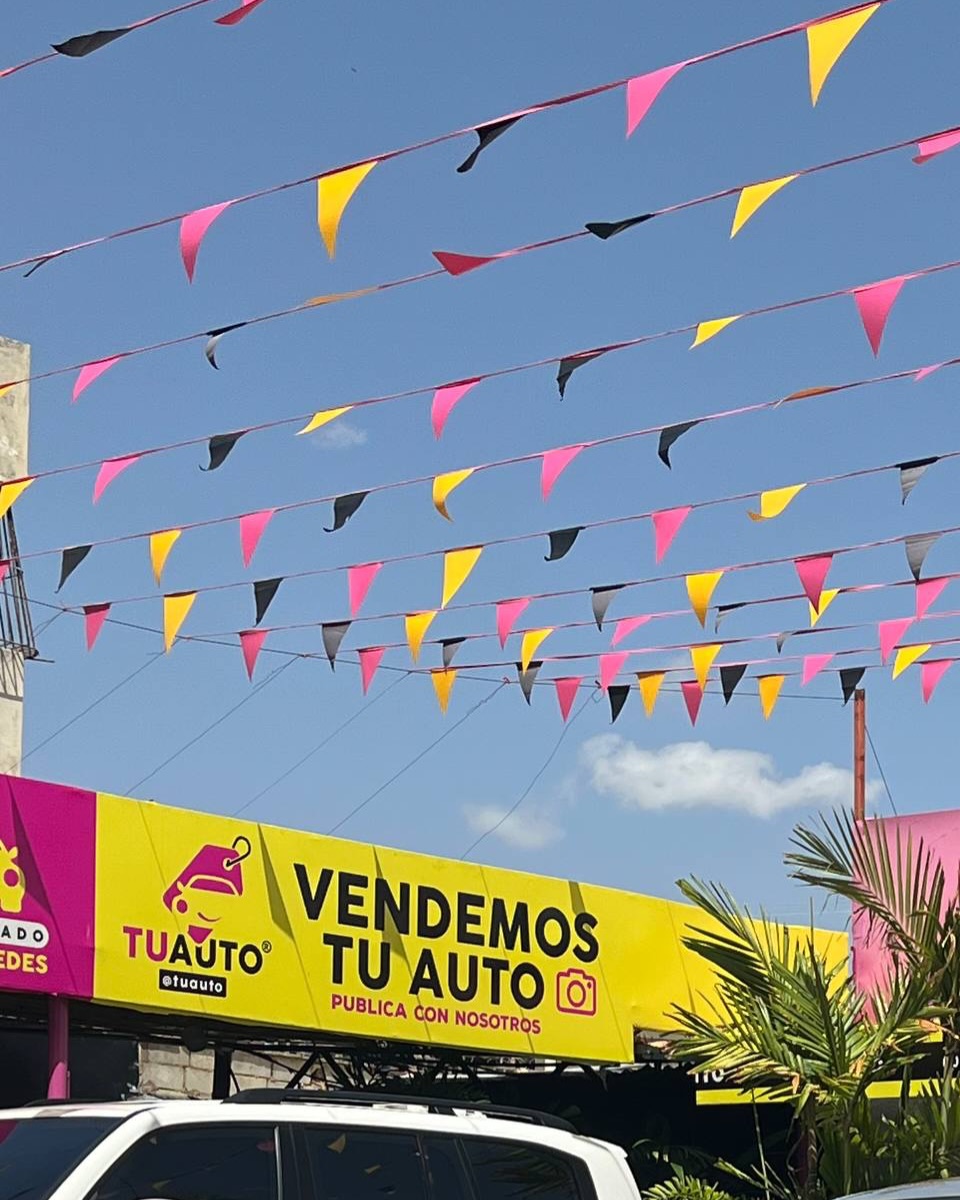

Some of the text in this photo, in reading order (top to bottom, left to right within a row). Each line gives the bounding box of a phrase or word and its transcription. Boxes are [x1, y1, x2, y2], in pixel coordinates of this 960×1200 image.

[293, 863, 599, 963] VENDEMOS
[162, 974, 224, 993] @tuauto
[323, 933, 545, 1010] TU AUTO
[331, 994, 541, 1034] PUBLICA CON NOSOTROS
